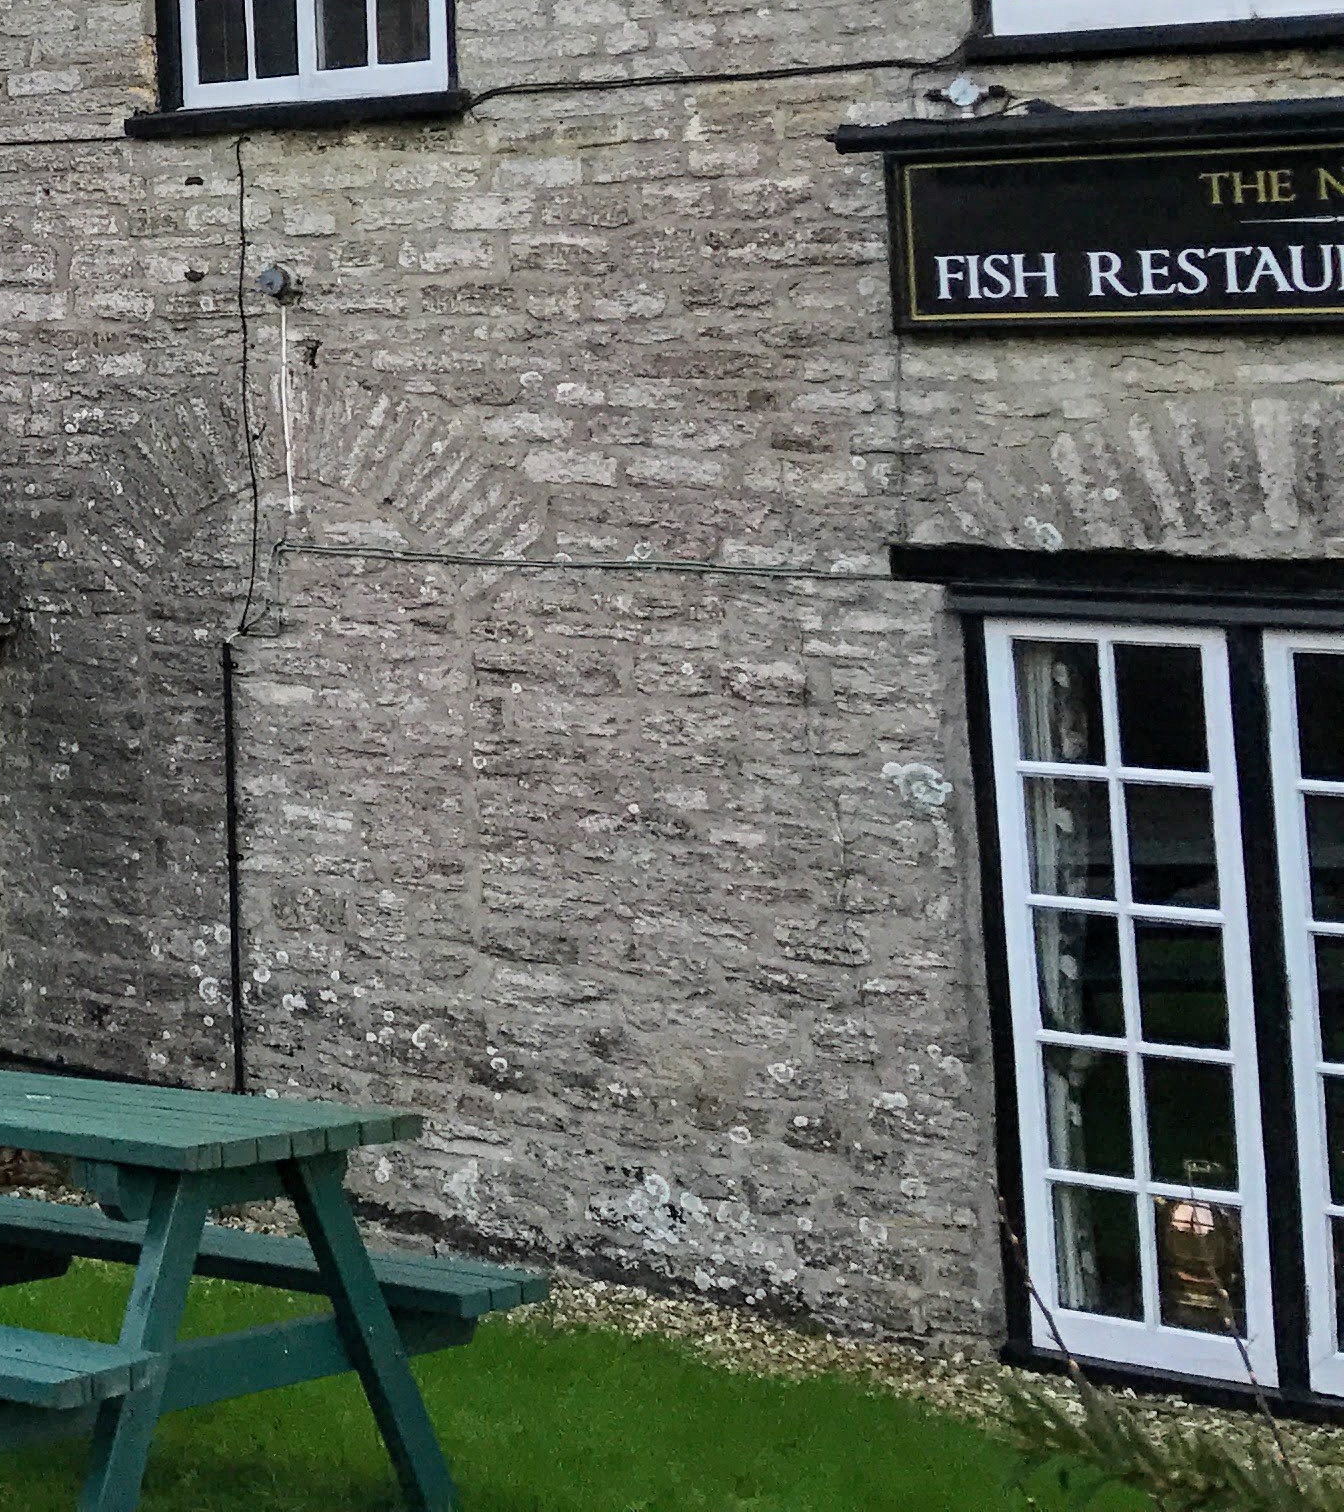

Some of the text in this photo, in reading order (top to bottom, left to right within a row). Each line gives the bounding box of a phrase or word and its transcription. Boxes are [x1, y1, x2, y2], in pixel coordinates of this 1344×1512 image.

[1198, 169, 1296, 205] THE
[934, 243, 1344, 300] FISH RESTAU
